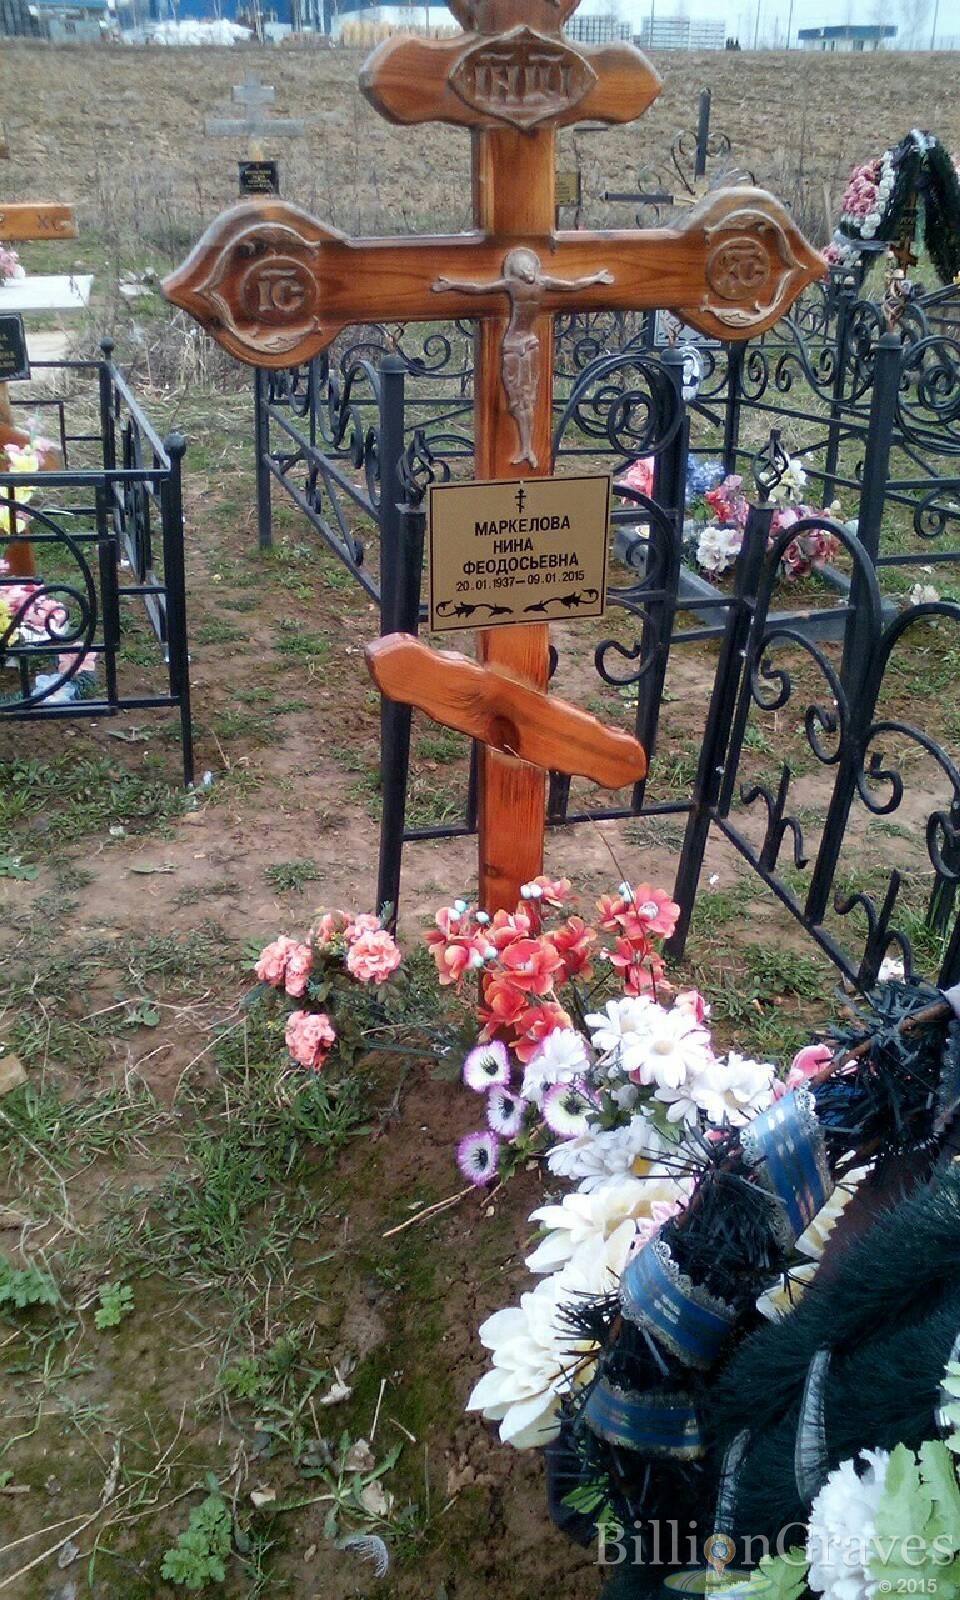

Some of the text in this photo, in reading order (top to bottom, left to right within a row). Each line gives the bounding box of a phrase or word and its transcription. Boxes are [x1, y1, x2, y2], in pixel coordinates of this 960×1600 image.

[474, 515, 571, 536] МАРКЕЛОВА
[493, 537, 534, 554] НИНА
[463, 552, 579, 575] ФЕОДОСЬЕВНА
